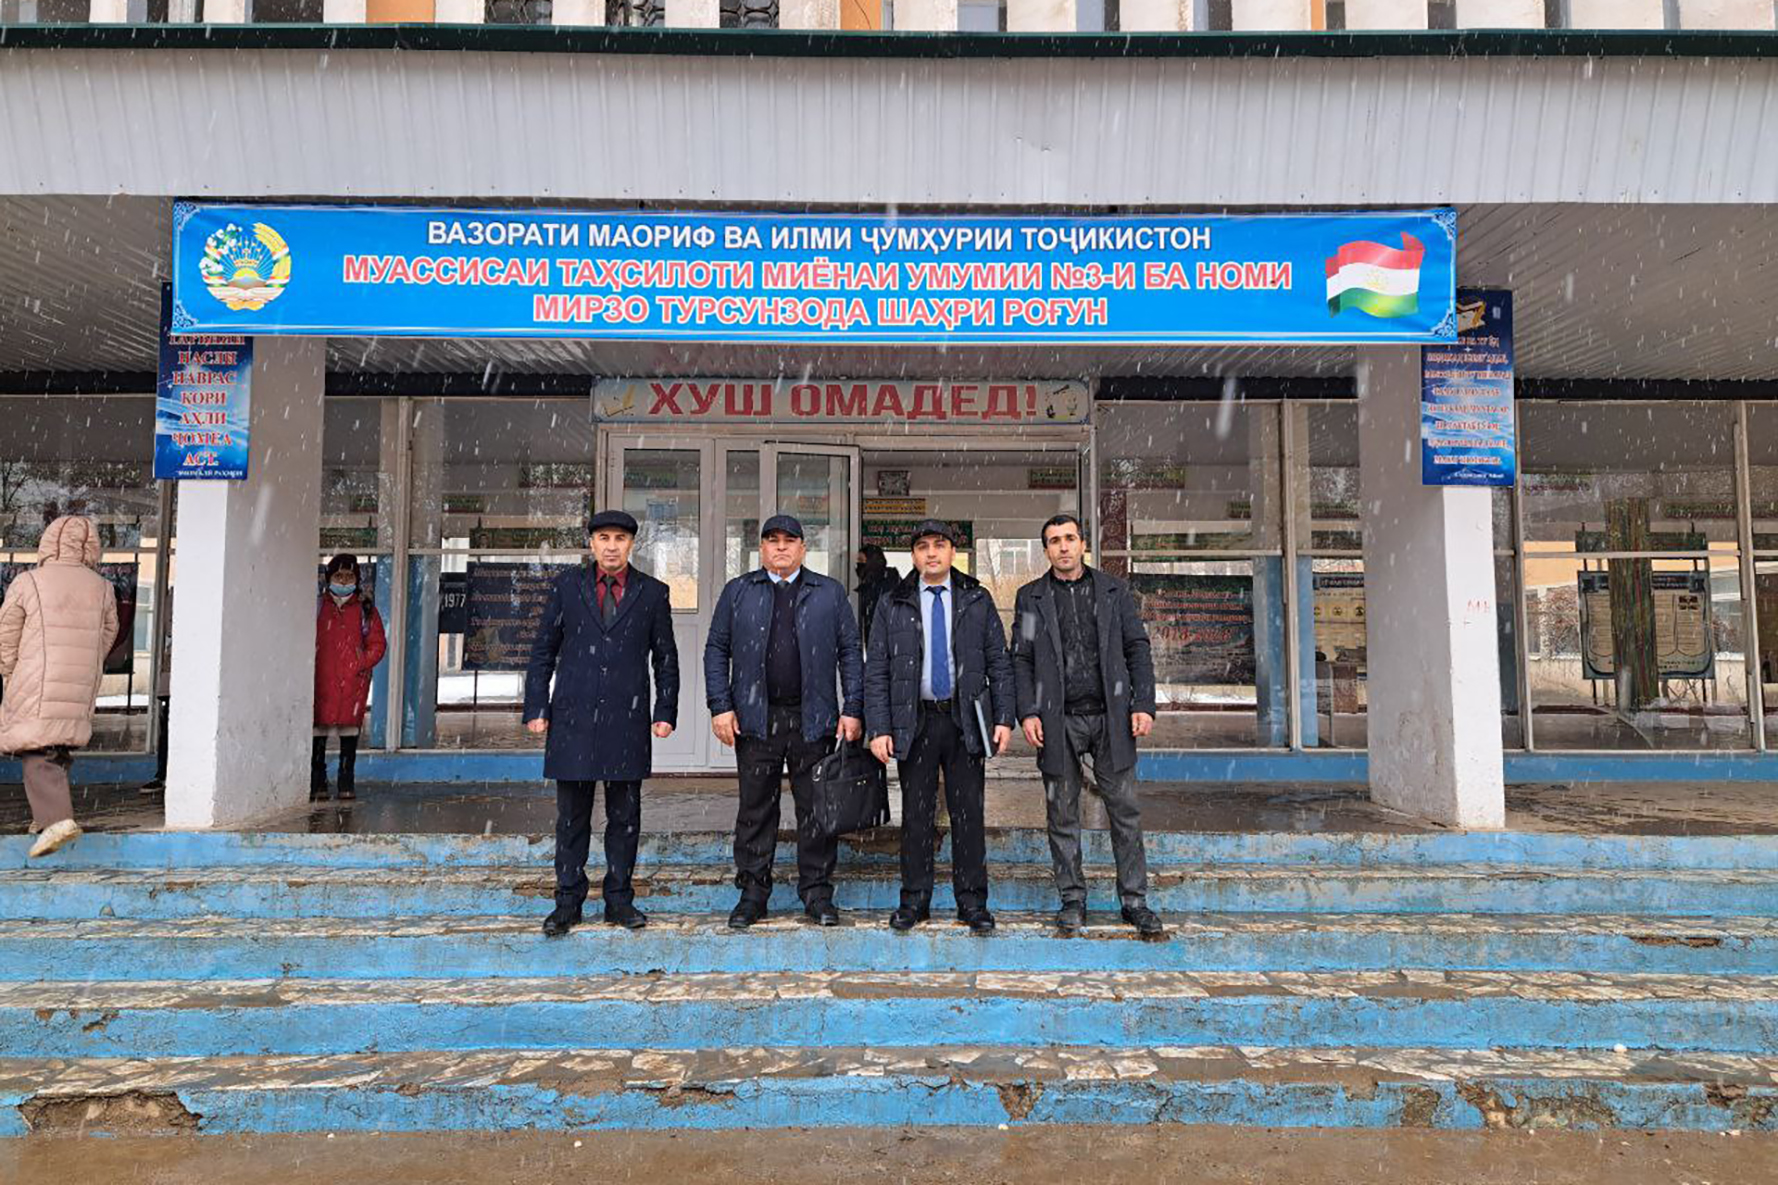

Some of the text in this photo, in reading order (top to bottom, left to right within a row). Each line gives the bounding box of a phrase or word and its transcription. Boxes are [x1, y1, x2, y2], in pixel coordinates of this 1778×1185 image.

[428, 221, 1212, 255] ВАЗОРАТИ МАОРИФ ВА ИЛМИ ҶУМҲУРИИ ТОҶИКИСТОН
[343, 254, 1292, 291] МУАССИСАИ ТАҲСИЛОТИ МИЁНАИ УМУМИИ №3-И БА НОМИ
[532, 294, 1108, 330] МИРЗО ТУРСУНЗОДА ШАҲРИ РОҒУН
[172, 371, 238, 385] НАВРАС
[180, 391, 227, 405] КОРИ
[648, 382, 1038, 420] ХУШ ОМАДЕД!
